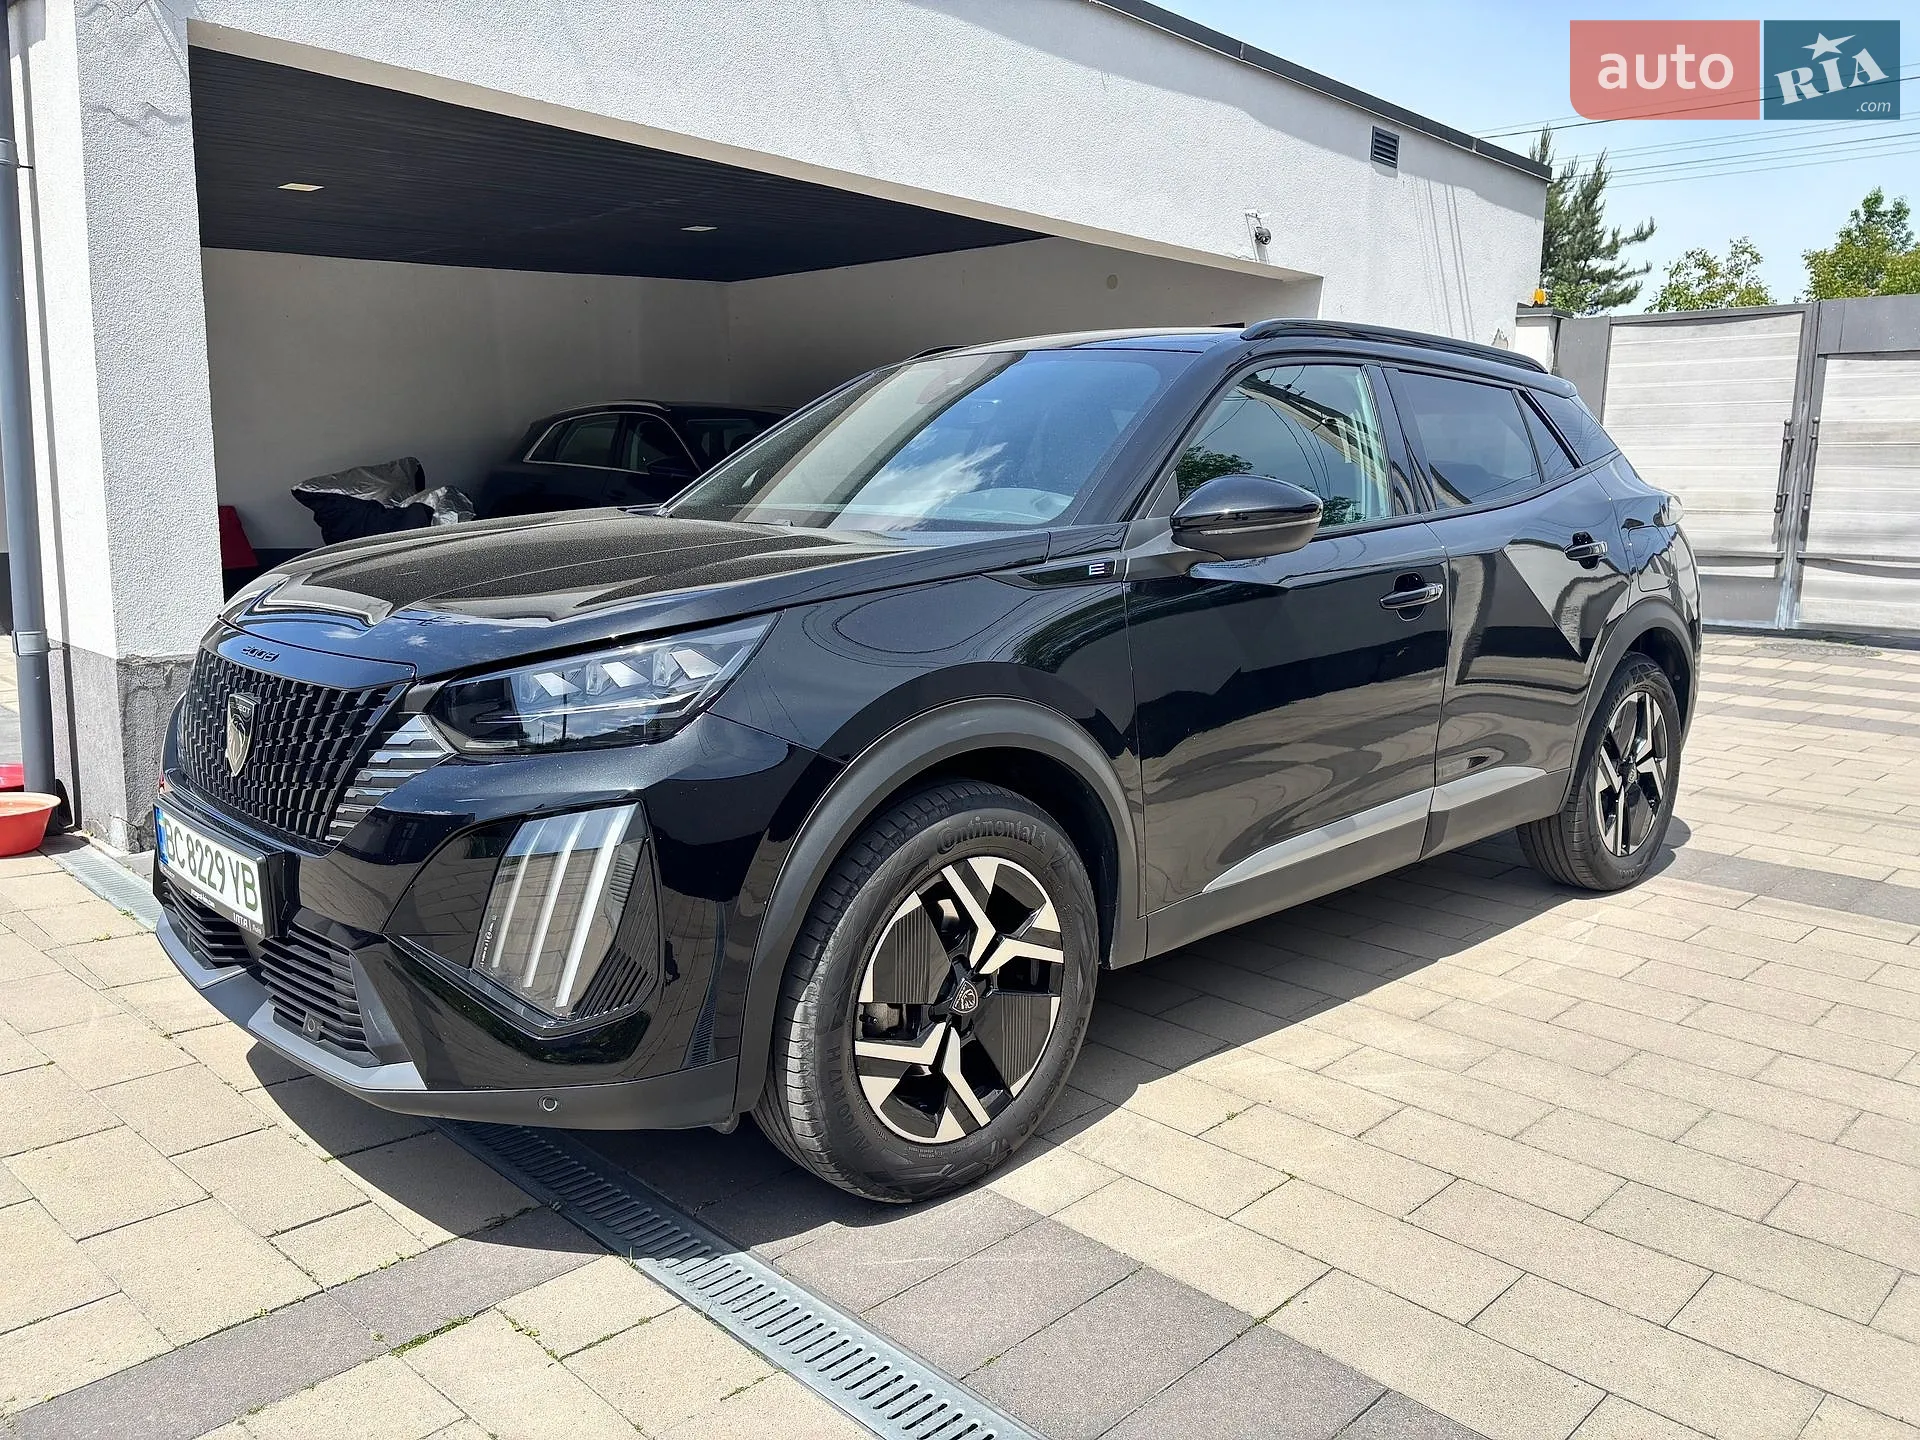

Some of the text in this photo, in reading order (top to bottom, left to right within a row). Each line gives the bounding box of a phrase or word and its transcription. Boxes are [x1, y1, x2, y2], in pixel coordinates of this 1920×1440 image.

[241, 646, 280, 662] 2008
[936, 815, 1038, 855] Continental
[163, 817, 258, 912] BC 8229 YB
